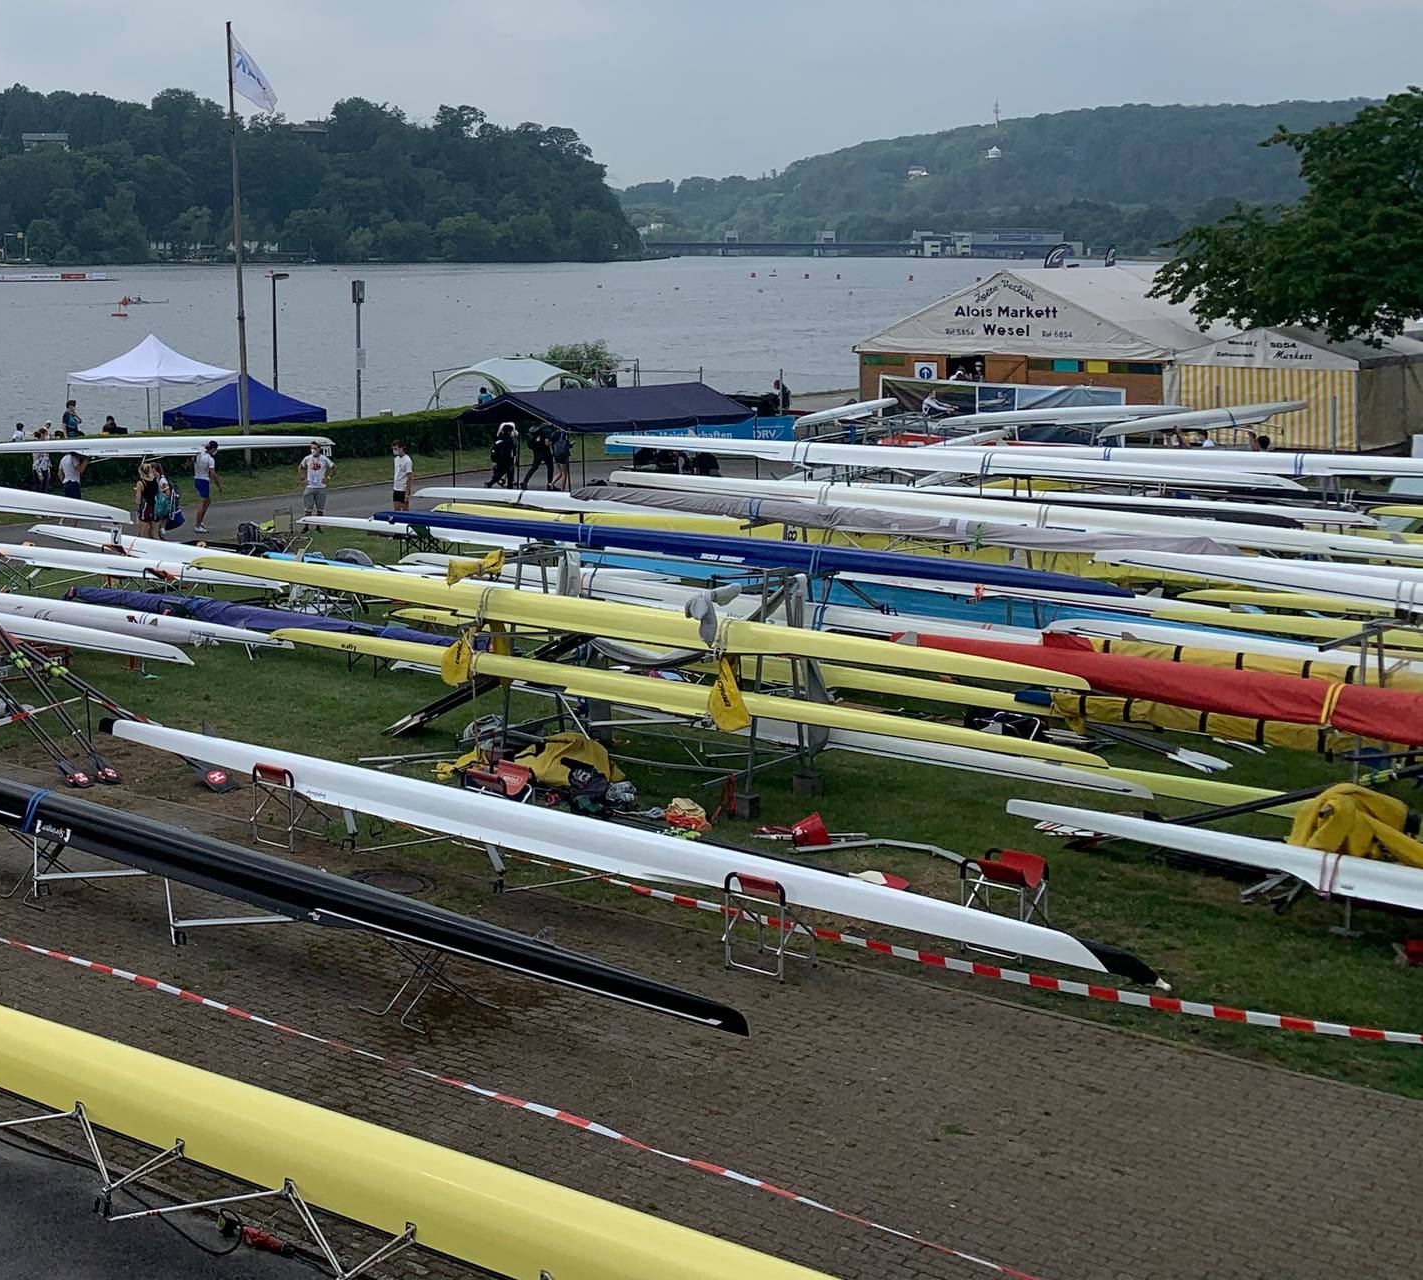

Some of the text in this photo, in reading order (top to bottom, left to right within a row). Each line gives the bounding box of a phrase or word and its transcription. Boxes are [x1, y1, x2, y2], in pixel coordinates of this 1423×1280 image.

[954, 305, 1058, 318] Alois Markett
[983, 324, 1030, 337] Wesel
